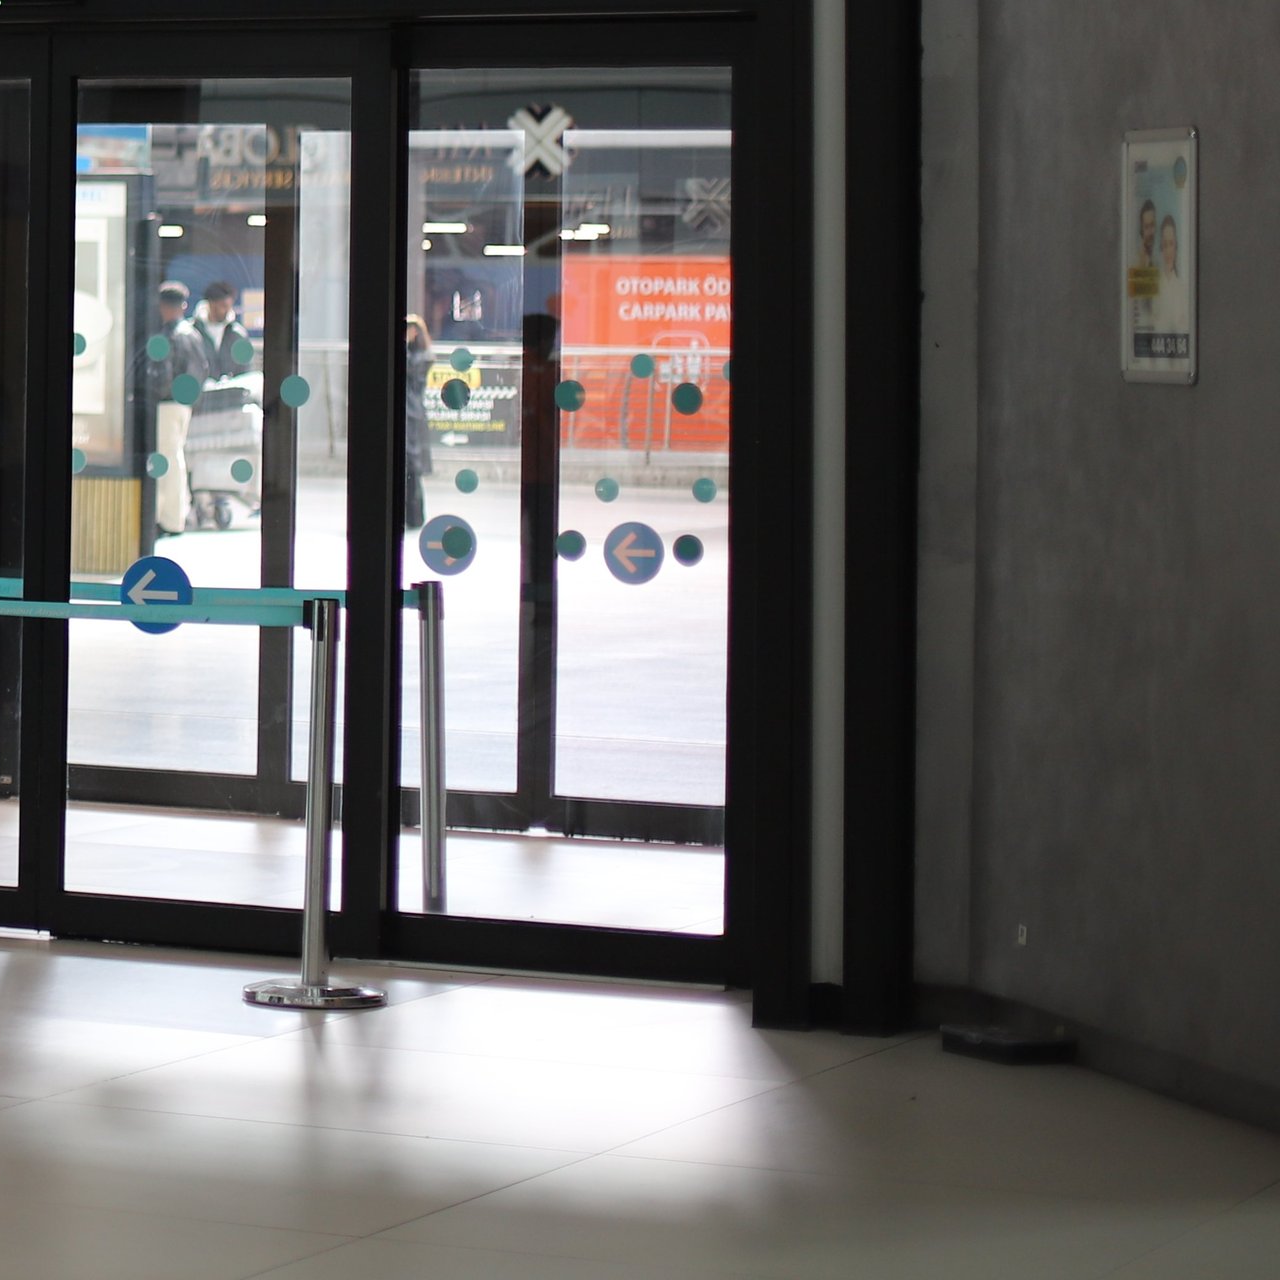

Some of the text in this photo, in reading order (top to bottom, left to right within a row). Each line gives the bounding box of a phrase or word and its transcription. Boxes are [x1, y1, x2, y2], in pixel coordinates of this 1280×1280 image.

[615, 276, 700, 296] OTOPARK
[618, 302, 731, 322] CARPARK PA
